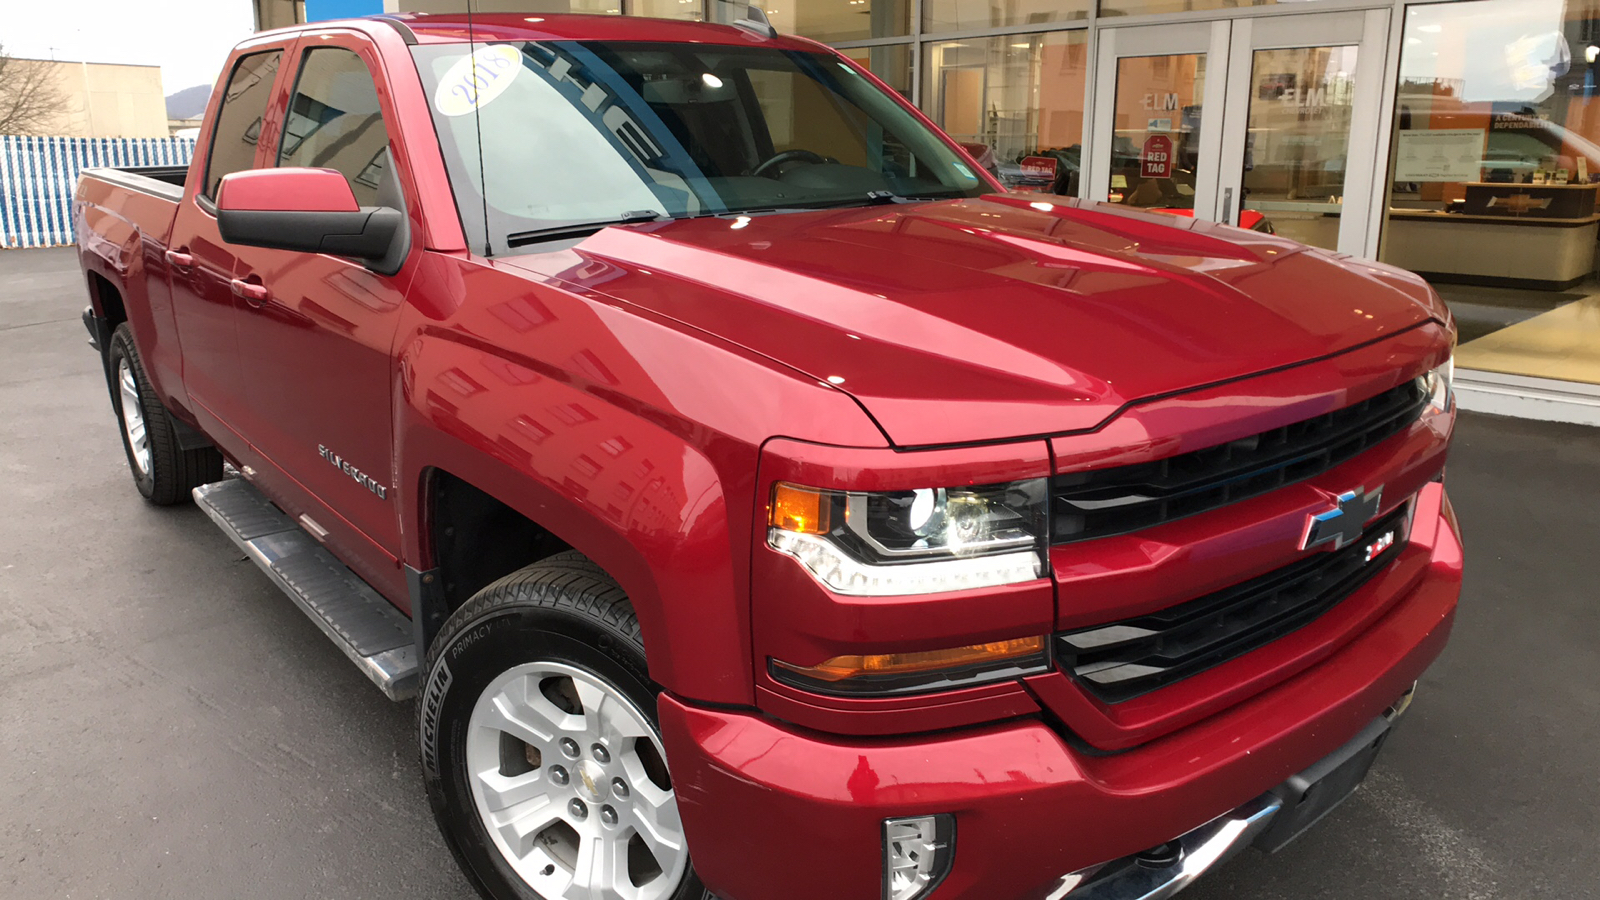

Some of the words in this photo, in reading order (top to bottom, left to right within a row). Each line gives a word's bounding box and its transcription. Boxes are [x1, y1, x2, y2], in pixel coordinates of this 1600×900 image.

[452, 52, 511, 105] 2018
[1140, 93, 1179, 111] ELM
[1278, 88, 1326, 107] ELM
[1494, 121, 1553, 130] DEPENDABILIT
[1147, 151, 1168, 162] RED
[1041, 166, 1053, 174] TAG
[1147, 163, 1166, 174] TAG
[318, 443, 387, 500] SILVERADO
[452, 622, 493, 660] PRIMACY
[424, 664, 449, 774] MICHELIN
